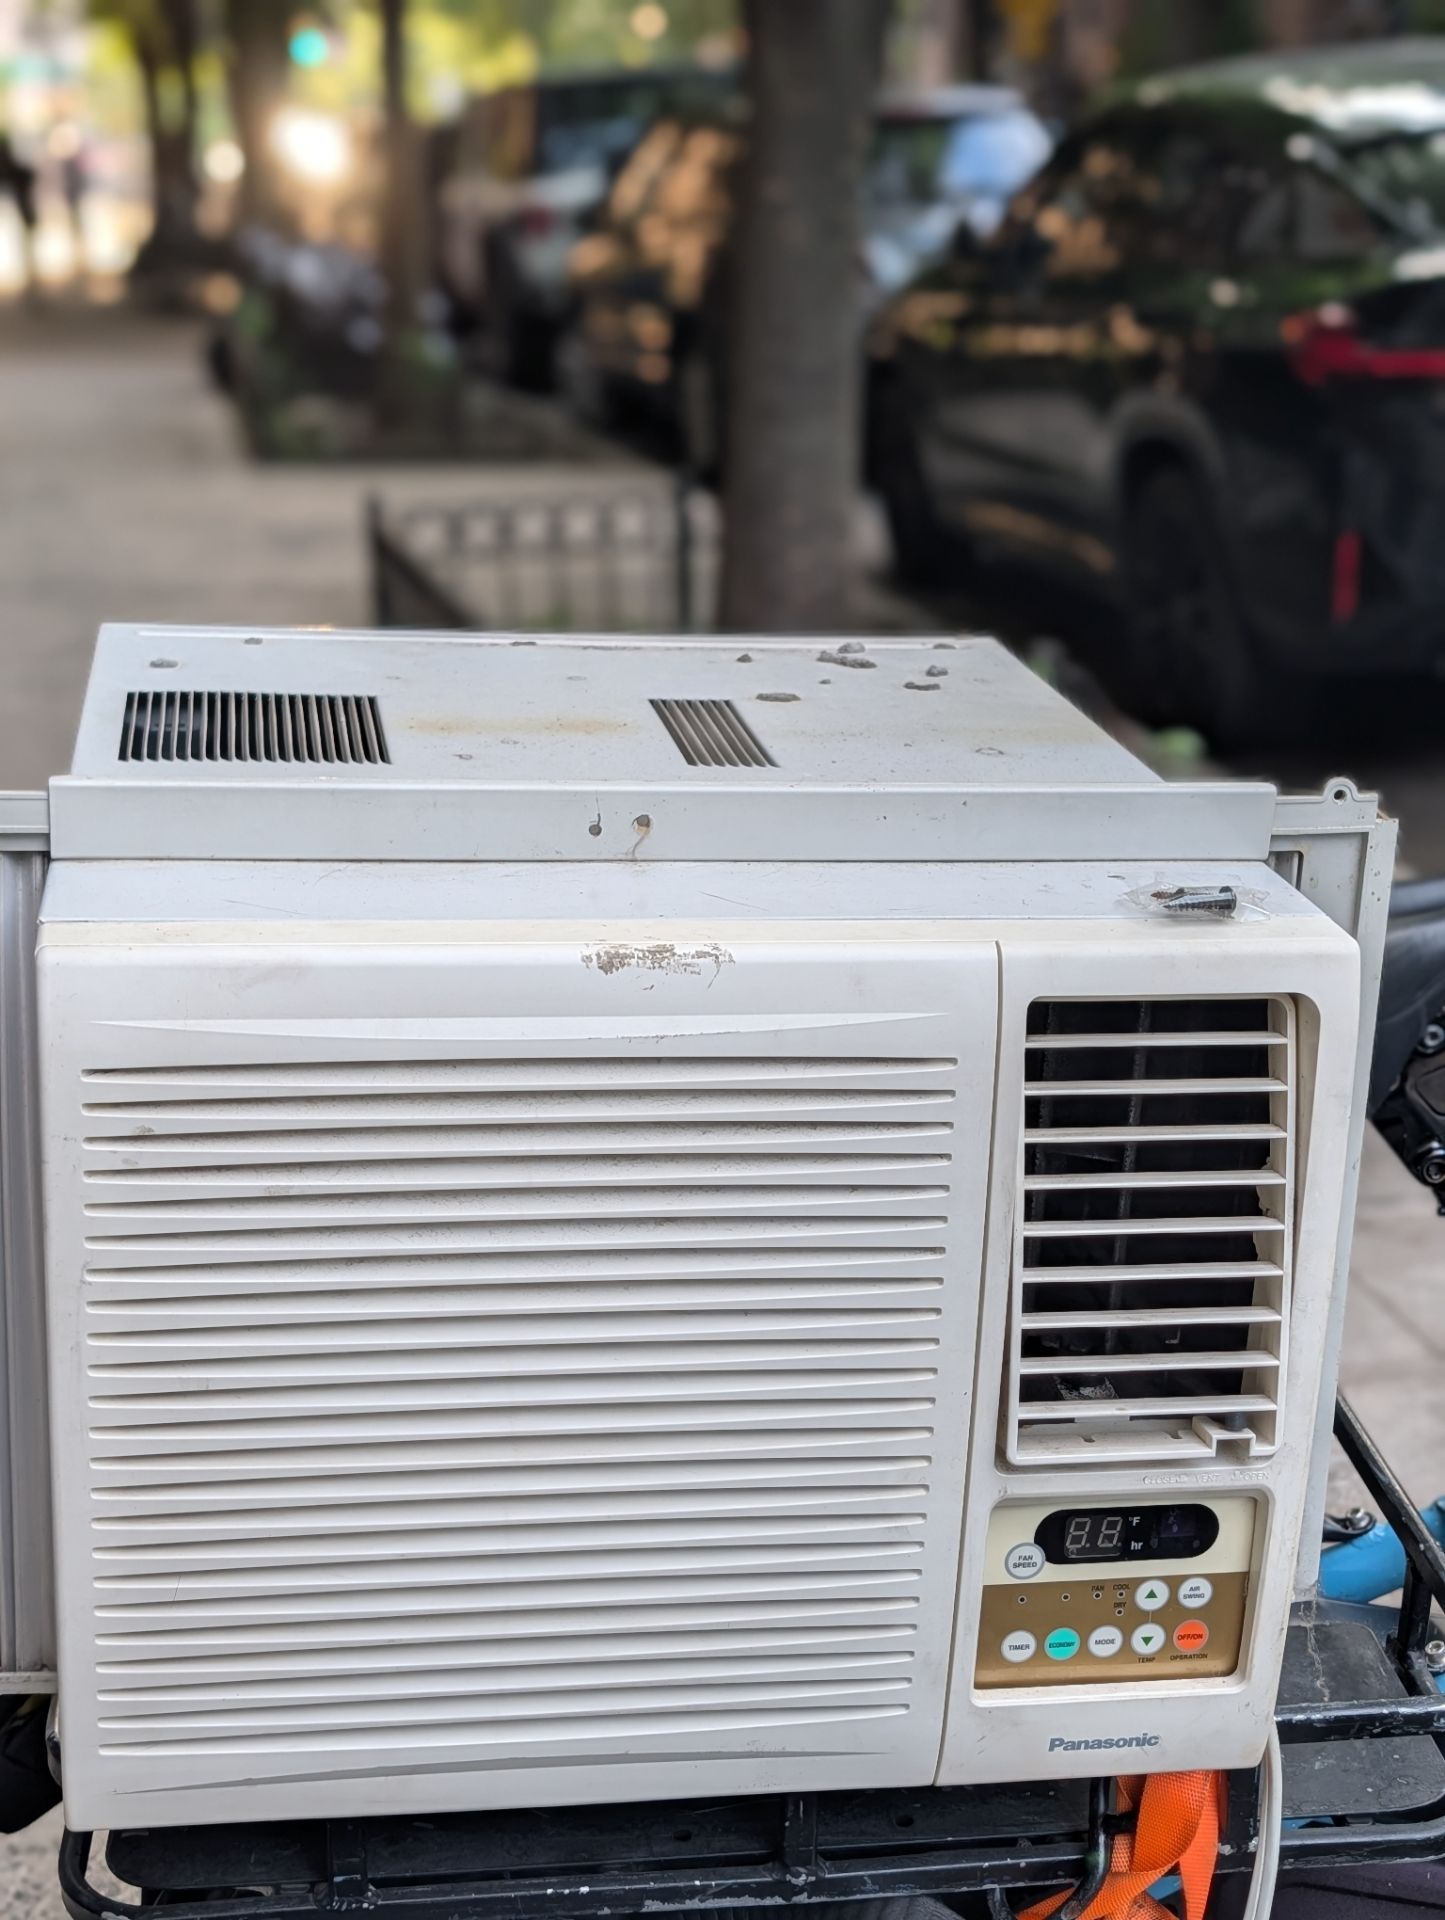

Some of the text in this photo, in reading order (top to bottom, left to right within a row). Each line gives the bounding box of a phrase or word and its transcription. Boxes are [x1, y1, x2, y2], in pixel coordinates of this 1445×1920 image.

[1130, 1541, 1143, 1550] hr
[1018, 1554, 1034, 1562] FAN
[1012, 1561, 1038, 1569] SPEED
[1112, 1583, 1130, 1591] COOL
[1182, 1592, 1205, 1600] SWING
[1176, 1633, 1204, 1641] OFF/ON
[1048, 1641, 1076, 1649] ECONOMY
[1094, 1638, 1116, 1646] MODE
[1008, 1643, 1031, 1652] TIMER
[1137, 1656, 1156, 1664] TEMP
[1169, 1652, 1208, 1662] OPERATION
[1048, 1732, 1160, 1753] Panasonic
